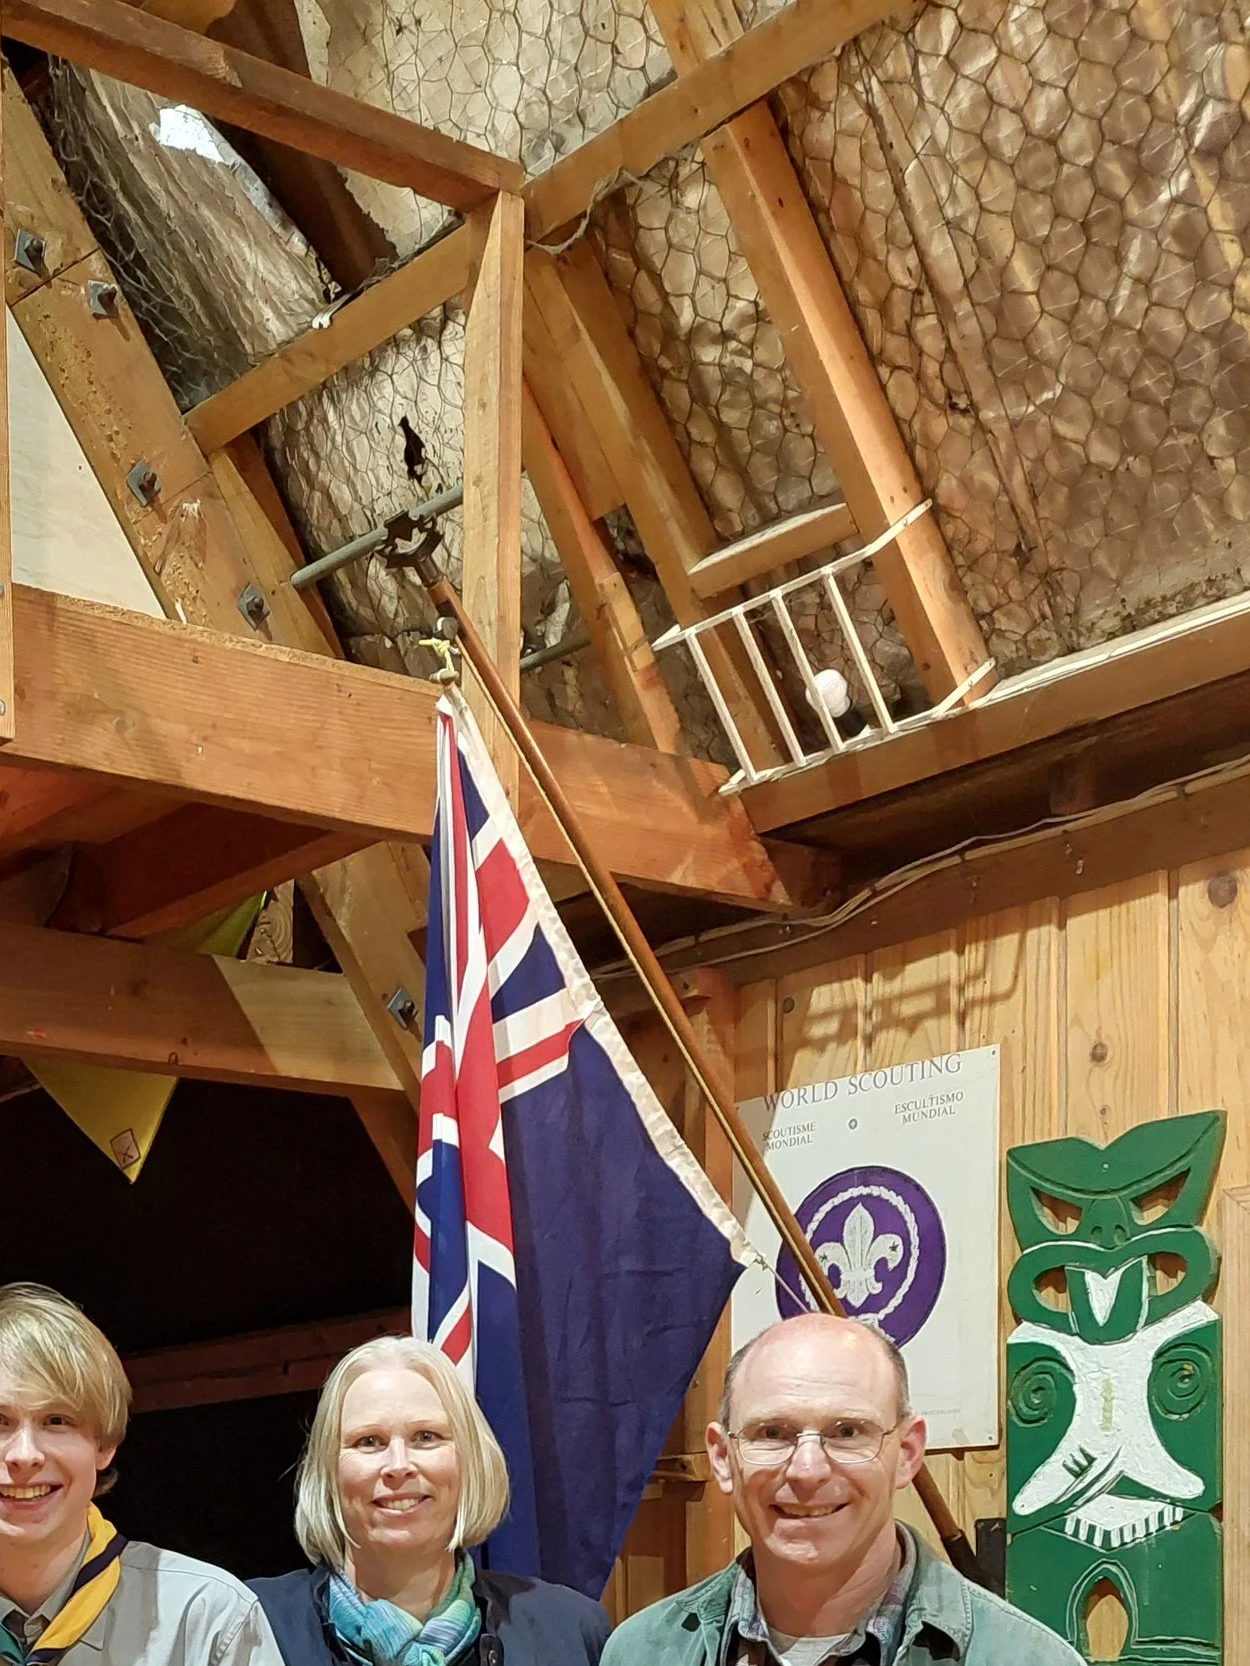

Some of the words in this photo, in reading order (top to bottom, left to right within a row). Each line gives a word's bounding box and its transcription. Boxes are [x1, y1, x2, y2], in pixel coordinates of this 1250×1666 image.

[763, 1081, 838, 1112] WORLD
[848, 1053, 962, 1095] SCOUTING
[894, 1091, 964, 1115] ESCULTISMO
[902, 1105, 956, 1125] MUNDIAL
[762, 1121, 817, 1141] SCOUTISME
[765, 1134, 813, 1151] MONDIAL
